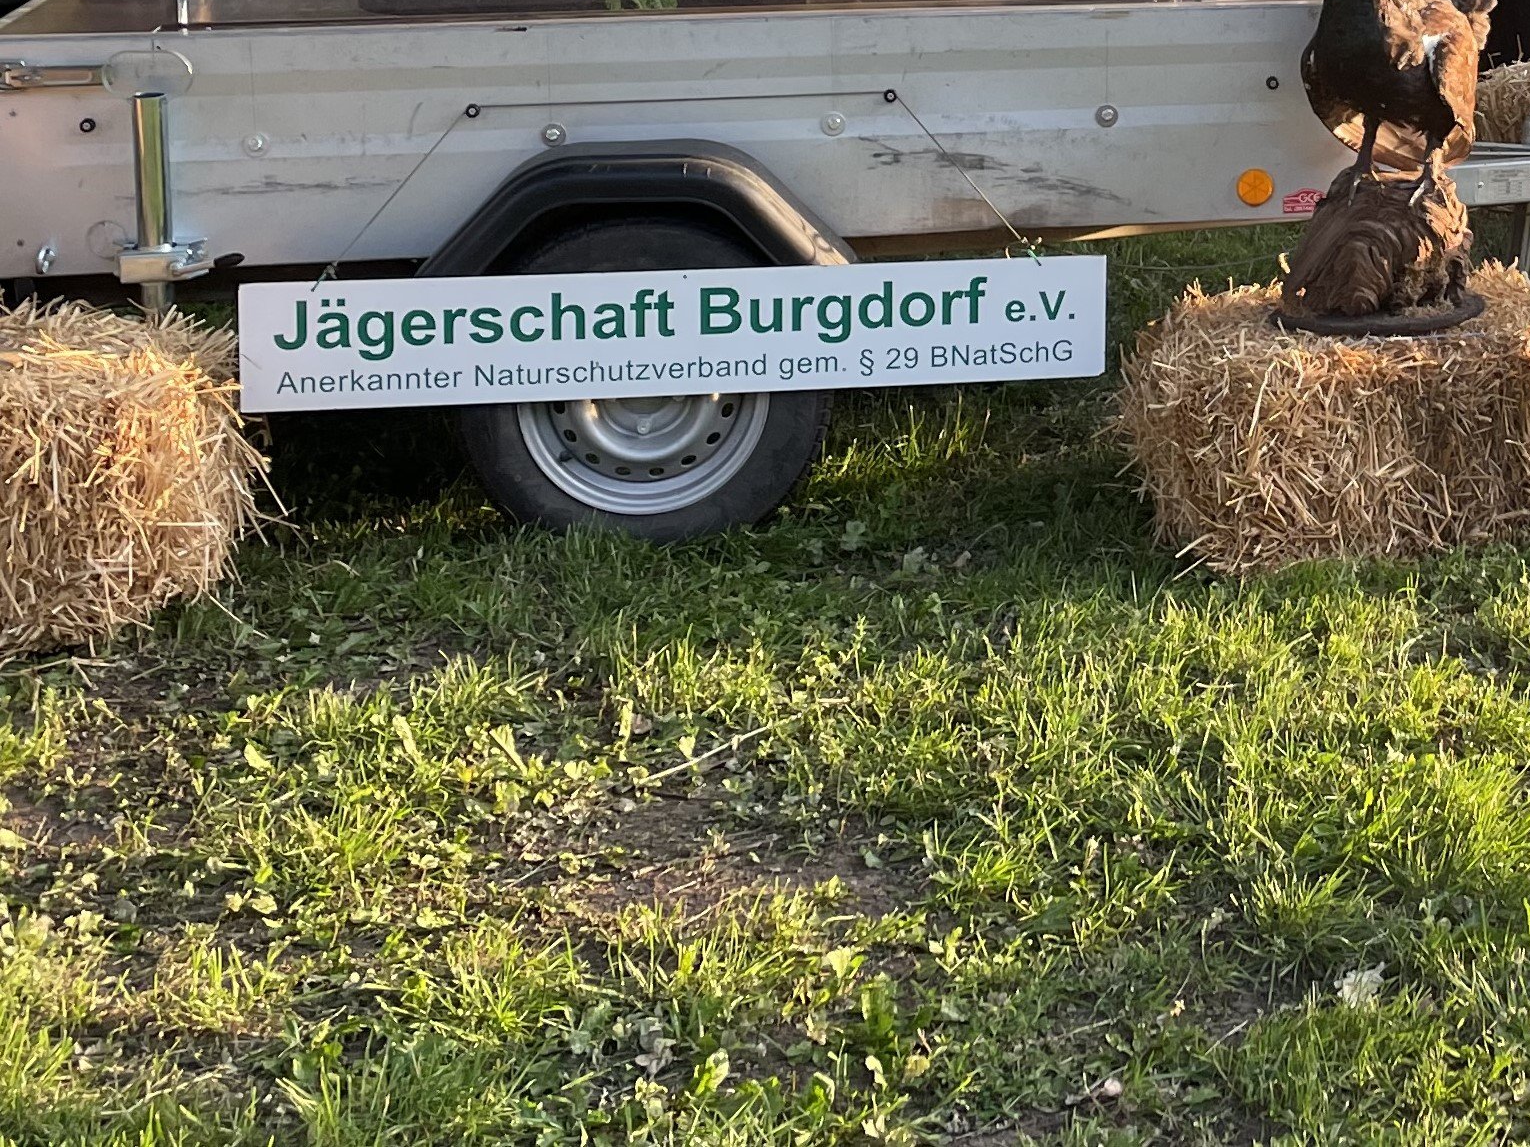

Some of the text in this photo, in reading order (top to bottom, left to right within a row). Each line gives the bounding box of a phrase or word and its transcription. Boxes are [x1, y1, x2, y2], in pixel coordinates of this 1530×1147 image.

[273, 277, 1075, 360] Jägerschaft Burgdorf e.V.
[276, 340, 1073, 394] Anerkannter Naturschutzverband gem. § 29 BNatSchG
